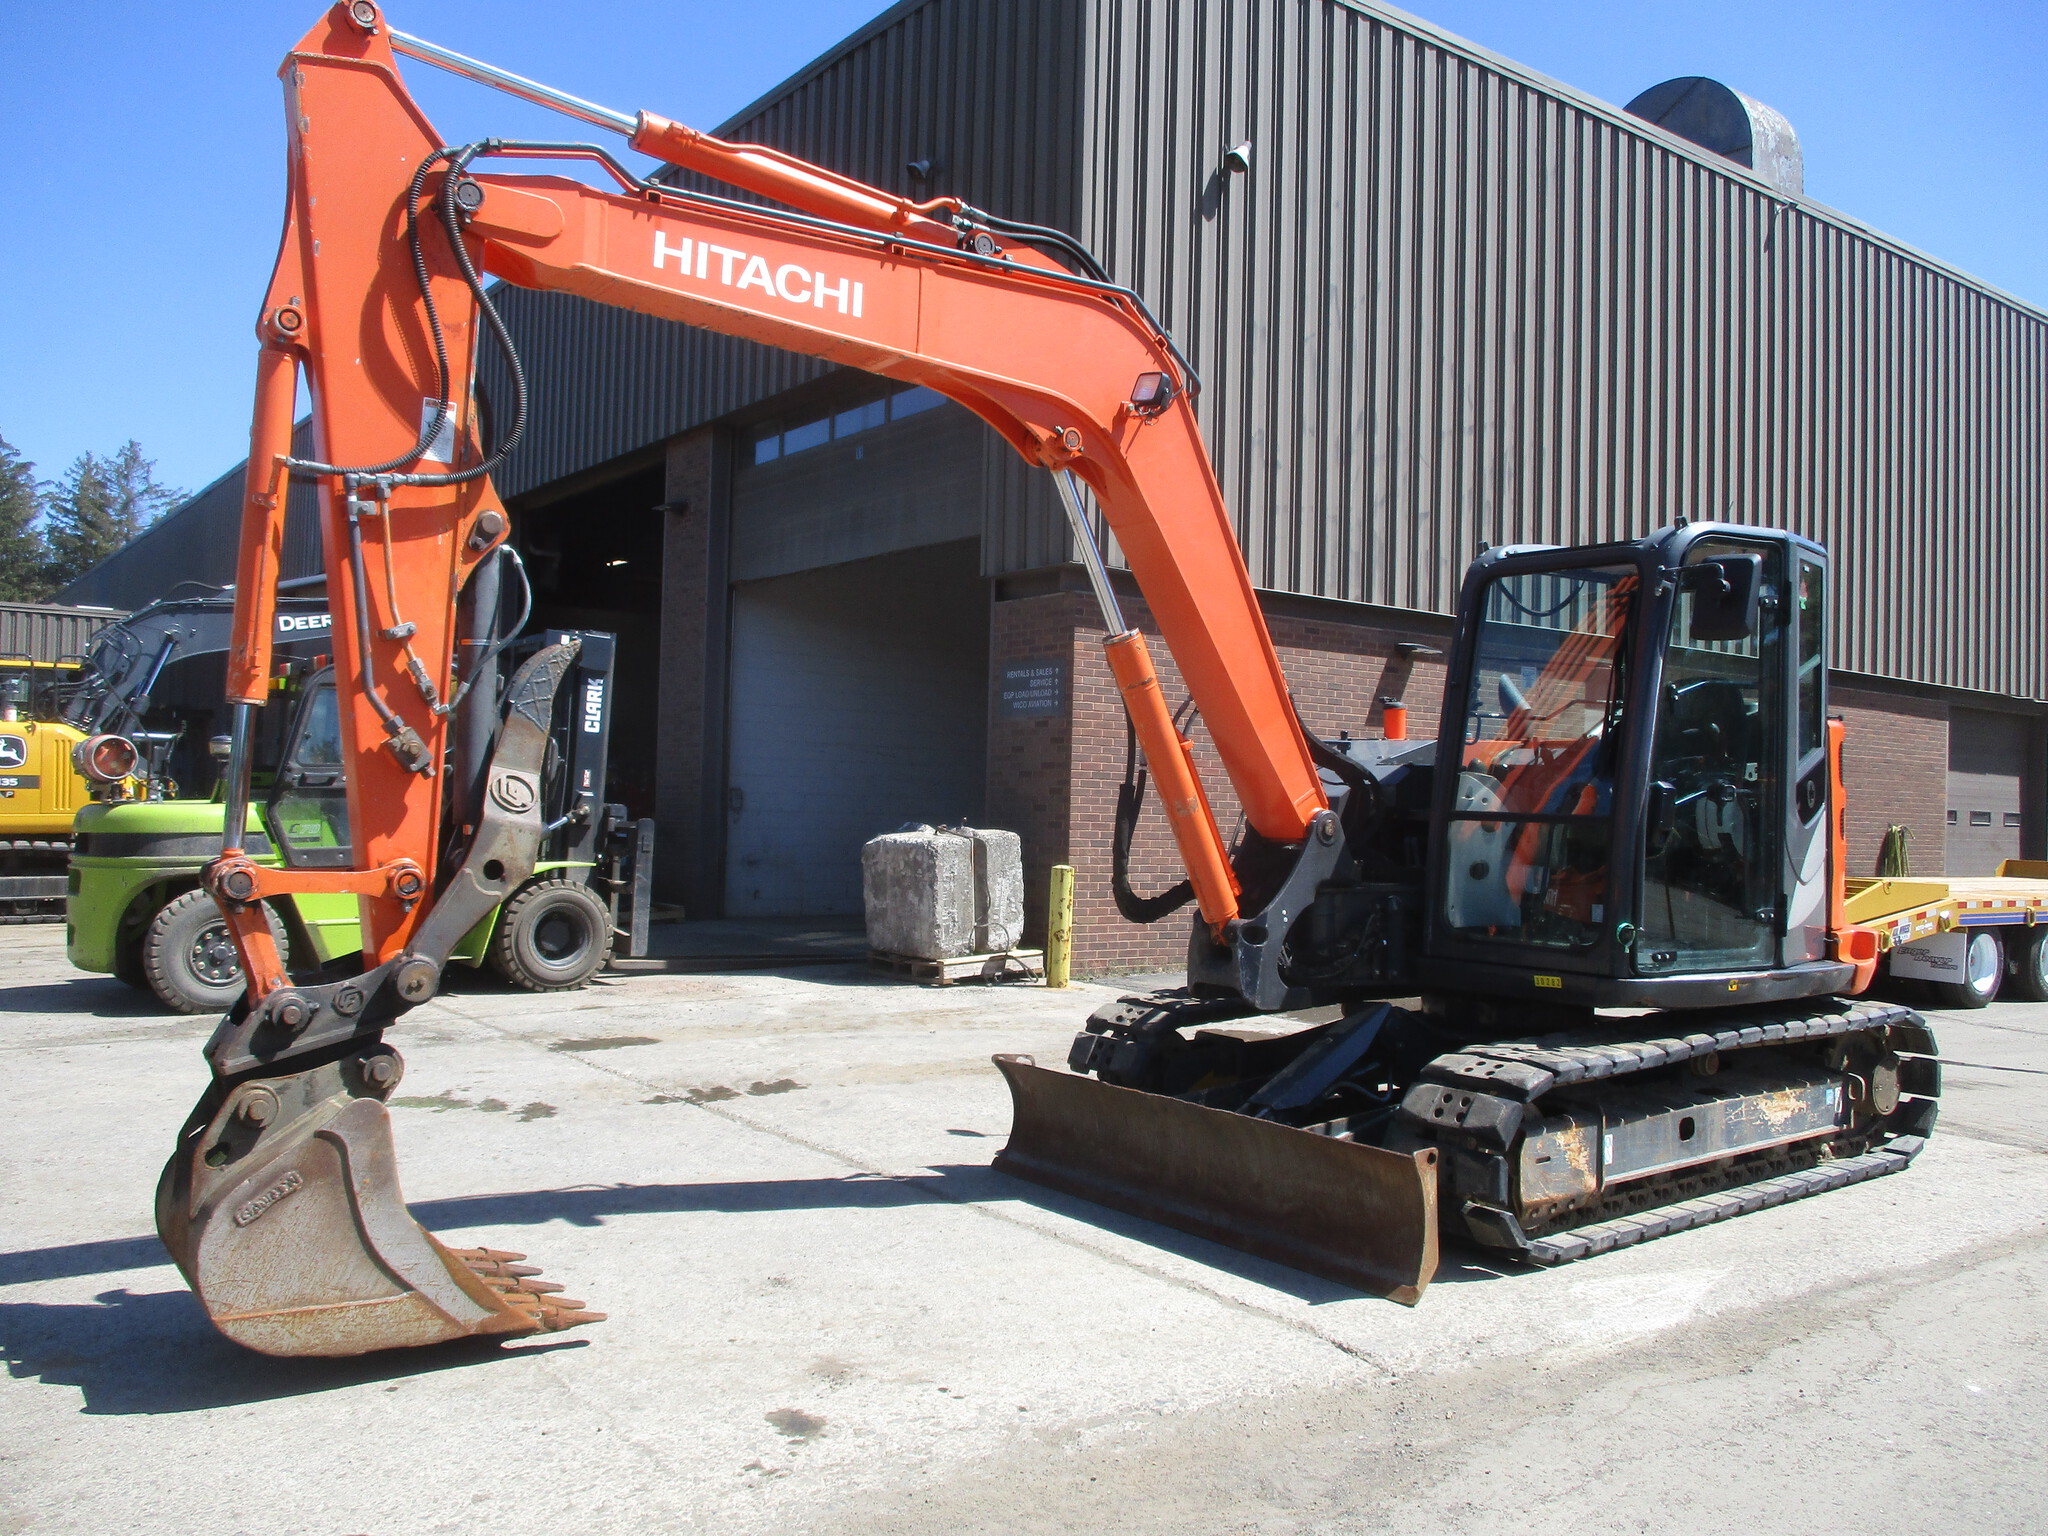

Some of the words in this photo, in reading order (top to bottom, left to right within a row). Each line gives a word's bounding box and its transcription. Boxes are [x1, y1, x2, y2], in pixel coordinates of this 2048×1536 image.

[653, 230, 864, 319] HITACHI
[278, 614, 332, 632] DEER
[1006, 670, 1030, 679] RENTALS
[1036, 667, 1053, 676] SALES
[1029, 678, 1053, 687] SERVICE
[583, 678, 604, 733] CLARK
